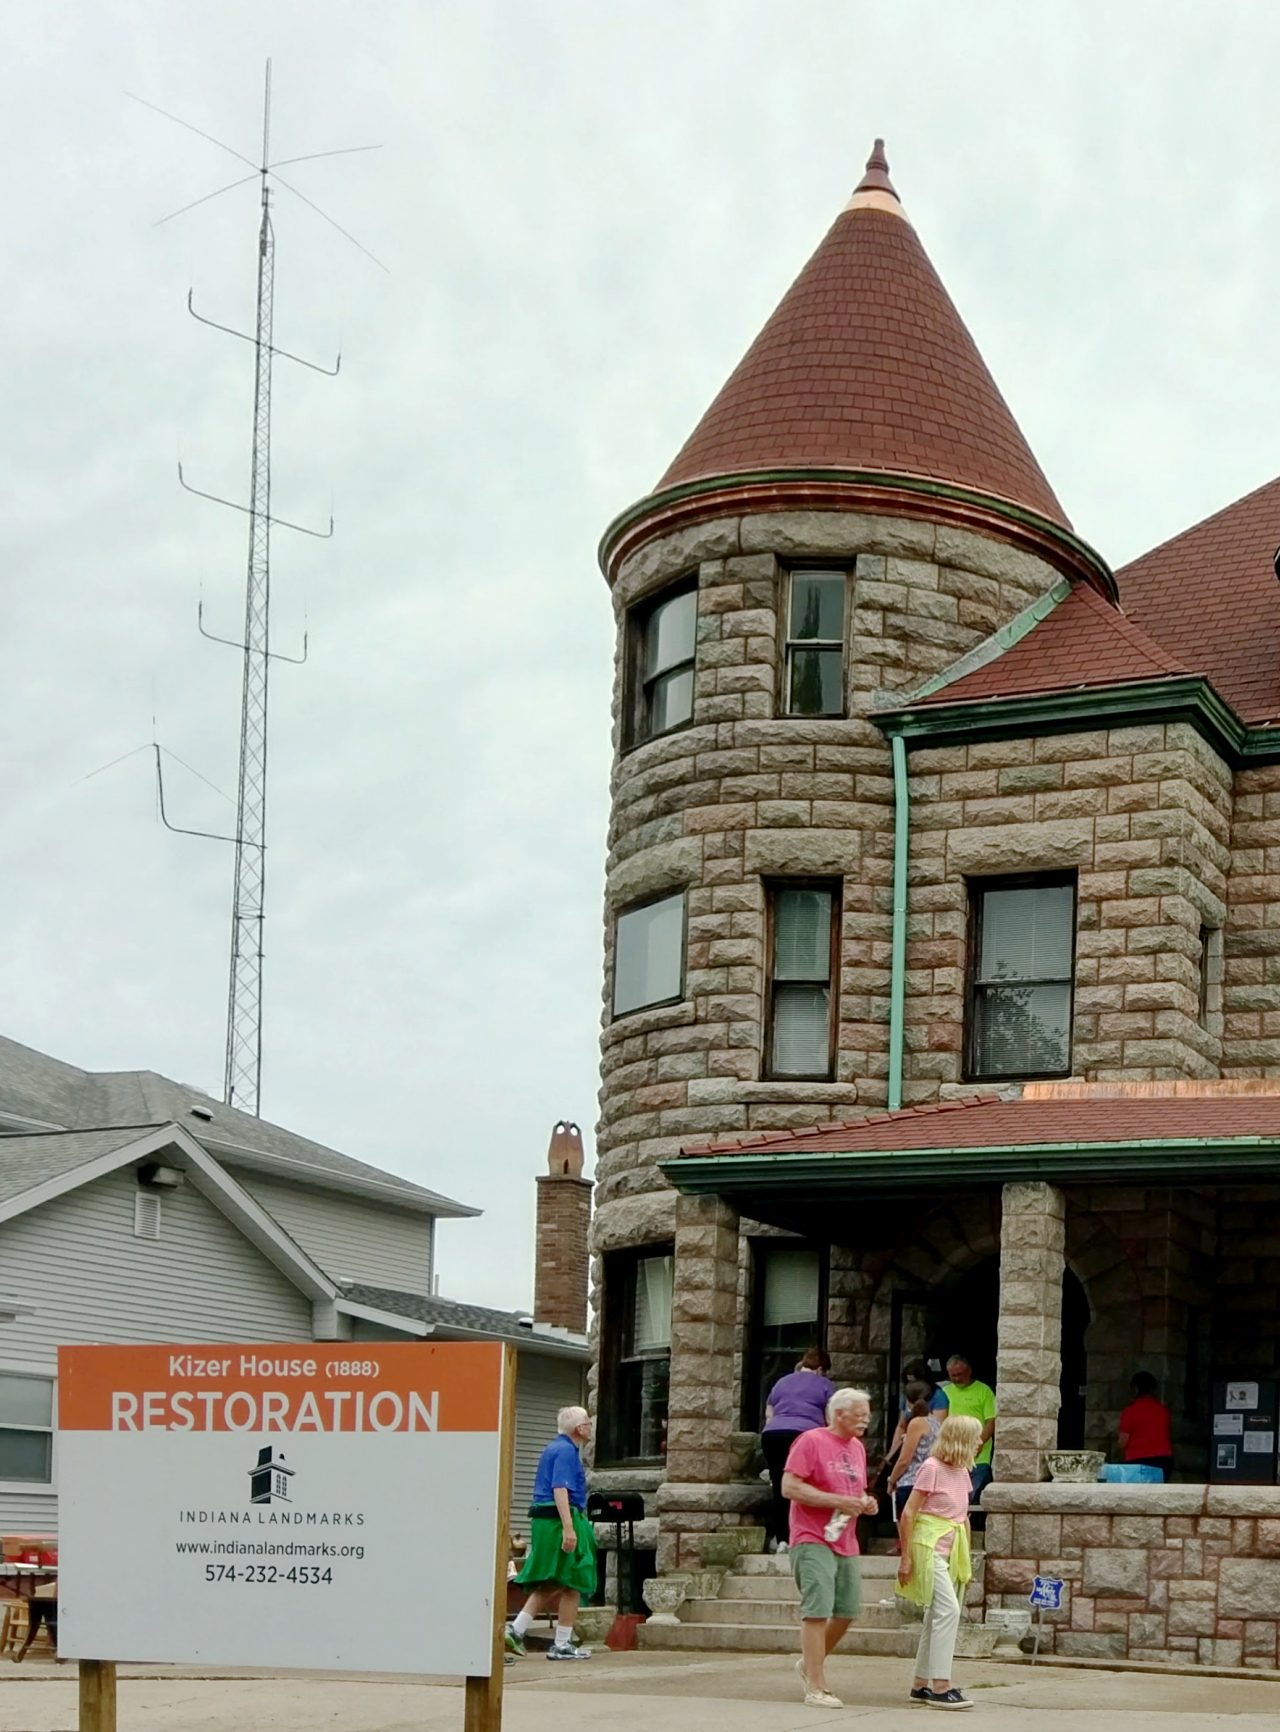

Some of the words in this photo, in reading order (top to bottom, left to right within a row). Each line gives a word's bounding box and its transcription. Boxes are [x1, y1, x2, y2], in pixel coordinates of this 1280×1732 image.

[169, 1355, 231, 1377] Kizer
[240, 1355, 317, 1377] House
[325, 1360, 380, 1379] (1888)
[111, 1390, 440, 1433] RESTORATION
[180, 1511, 251, 1525] INDIANA
[258, 1512, 365, 1526] LANDMARKS
[176, 1540, 365, 1559] www.indianalandmarks.org
[205, 1564, 333, 1585] 574-232-4534
